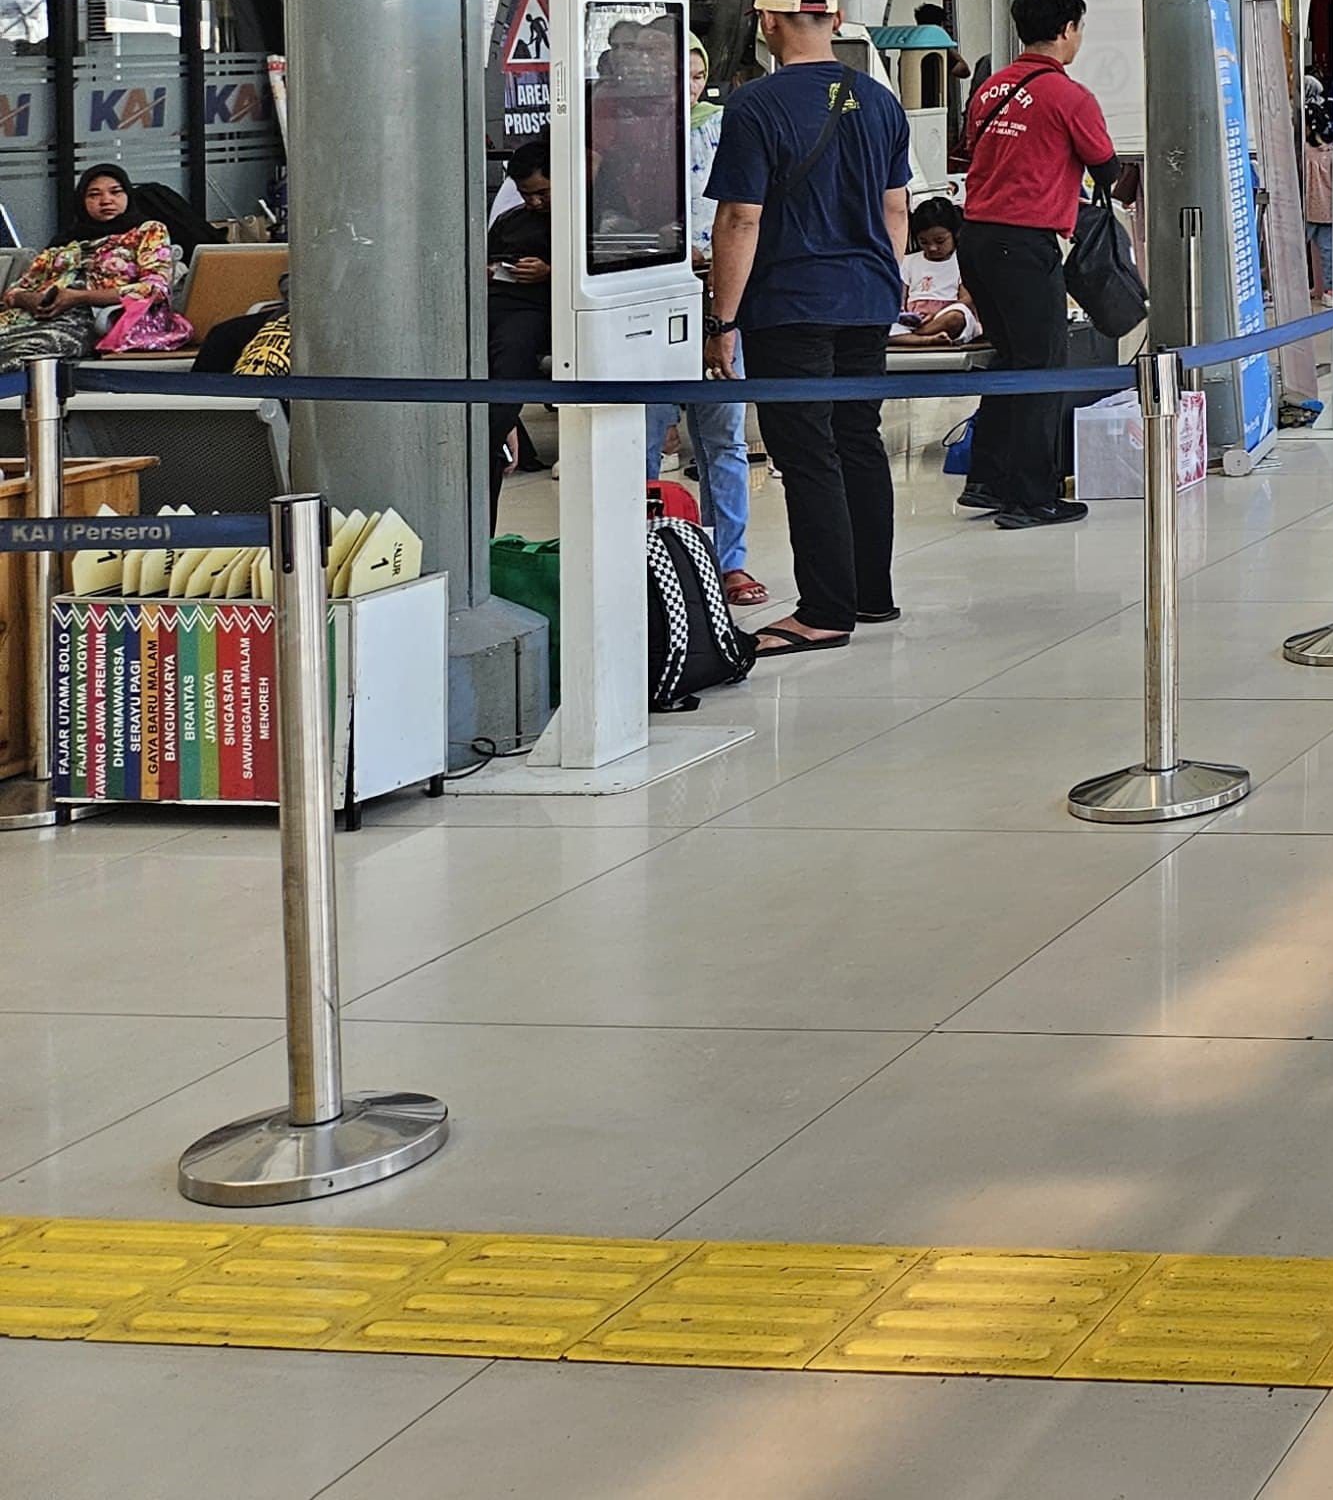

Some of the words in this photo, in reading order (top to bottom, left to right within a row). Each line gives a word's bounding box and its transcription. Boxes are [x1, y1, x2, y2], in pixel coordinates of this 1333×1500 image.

[0, 93, 31, 137] AI
[90, 87, 166, 132] KAI
[517, 84, 550, 106] AREA
[12, 523, 54, 543] KAI
[64, 522, 172, 542] (Persero)
[371, 557, 389, 570] 1
[58, 633, 70, 673] SOLO
[76, 633, 88, 682] YOGYA
[95, 633, 107, 697] PREMIUM
[130, 660, 141, 693] PAGI
[148, 640, 158, 691] MALAM
[240, 637, 251, 683] MALAM
[58, 675, 70, 725] UTAMA
[76, 682, 88, 731] UTAMA
[95, 700, 106, 740] JAWA
[113, 646, 125, 768] DHARMAWANGSA
[130, 696, 141, 752] SERAYU
[148, 694, 158, 739] BARU
[164, 654, 176, 762] BANGUNKARYA
[183, 674, 196, 741] BRANTAS
[204, 672, 216, 743] JAYABAYA
[223, 669, 236, 746] SINGASARI
[258, 677, 269, 740] MENOREH
[58, 729, 70, 775] FAJAR
[76, 733, 88, 777] FAJAR
[241, 686, 253, 779] SAWUNGGALIH
[95, 743, 106, 799] TAWANG
[148, 743, 158, 774] GAYA
